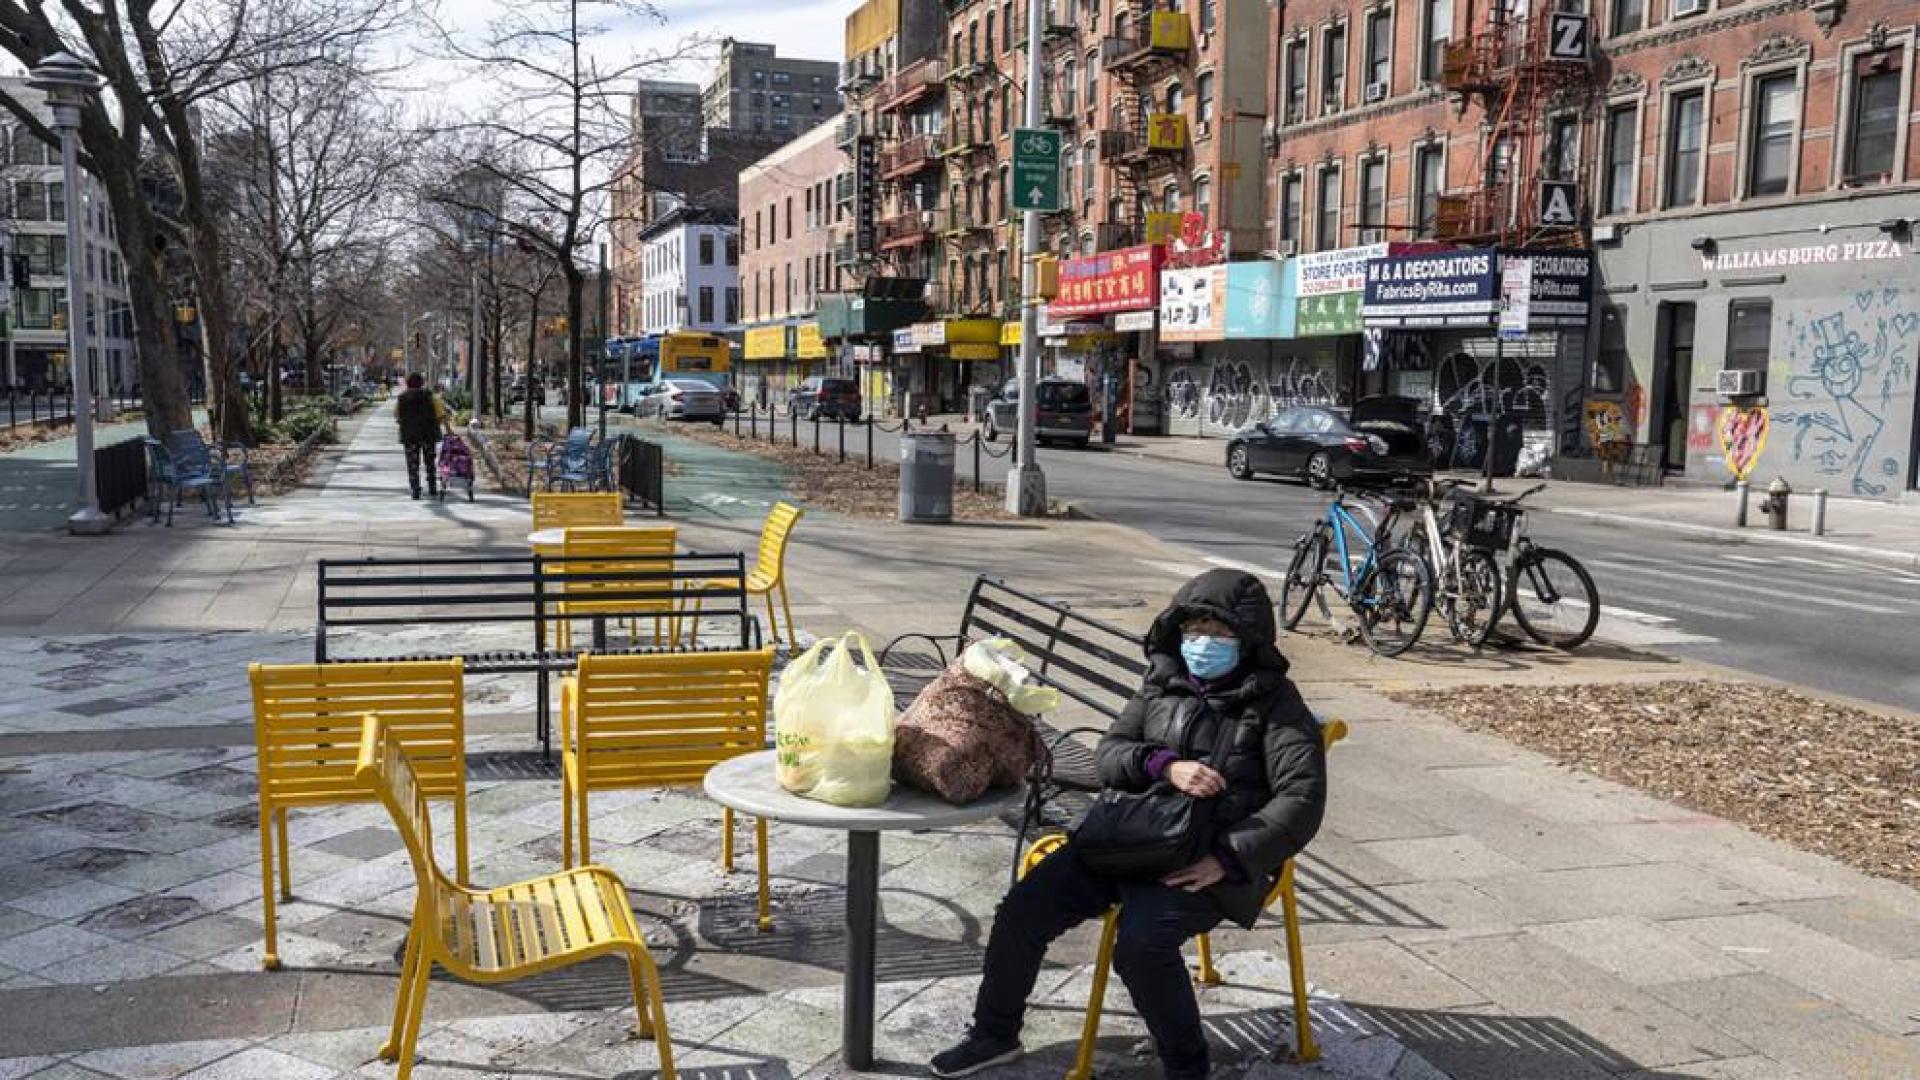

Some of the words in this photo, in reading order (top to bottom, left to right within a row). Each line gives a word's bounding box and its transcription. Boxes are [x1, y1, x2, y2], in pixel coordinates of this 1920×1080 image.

[1554, 18, 1583, 56] Z
[1543, 186, 1575, 222] A
[1533, 255, 1589, 276] ECORATORS
[1700, 244, 1839, 271] WILLIAMSBURG
[1843, 240, 1902, 260] PIZZA
[1302, 264, 1331, 280] STORE
[1334, 261, 1353, 278] FOR
[1368, 264, 1380, 281] M
[1382, 263, 1391, 280] &
[1393, 263, 1403, 280] A
[1405, 256, 1489, 279] DECORATORS
[1376, 281, 1478, 301] FabricsByRita.com
